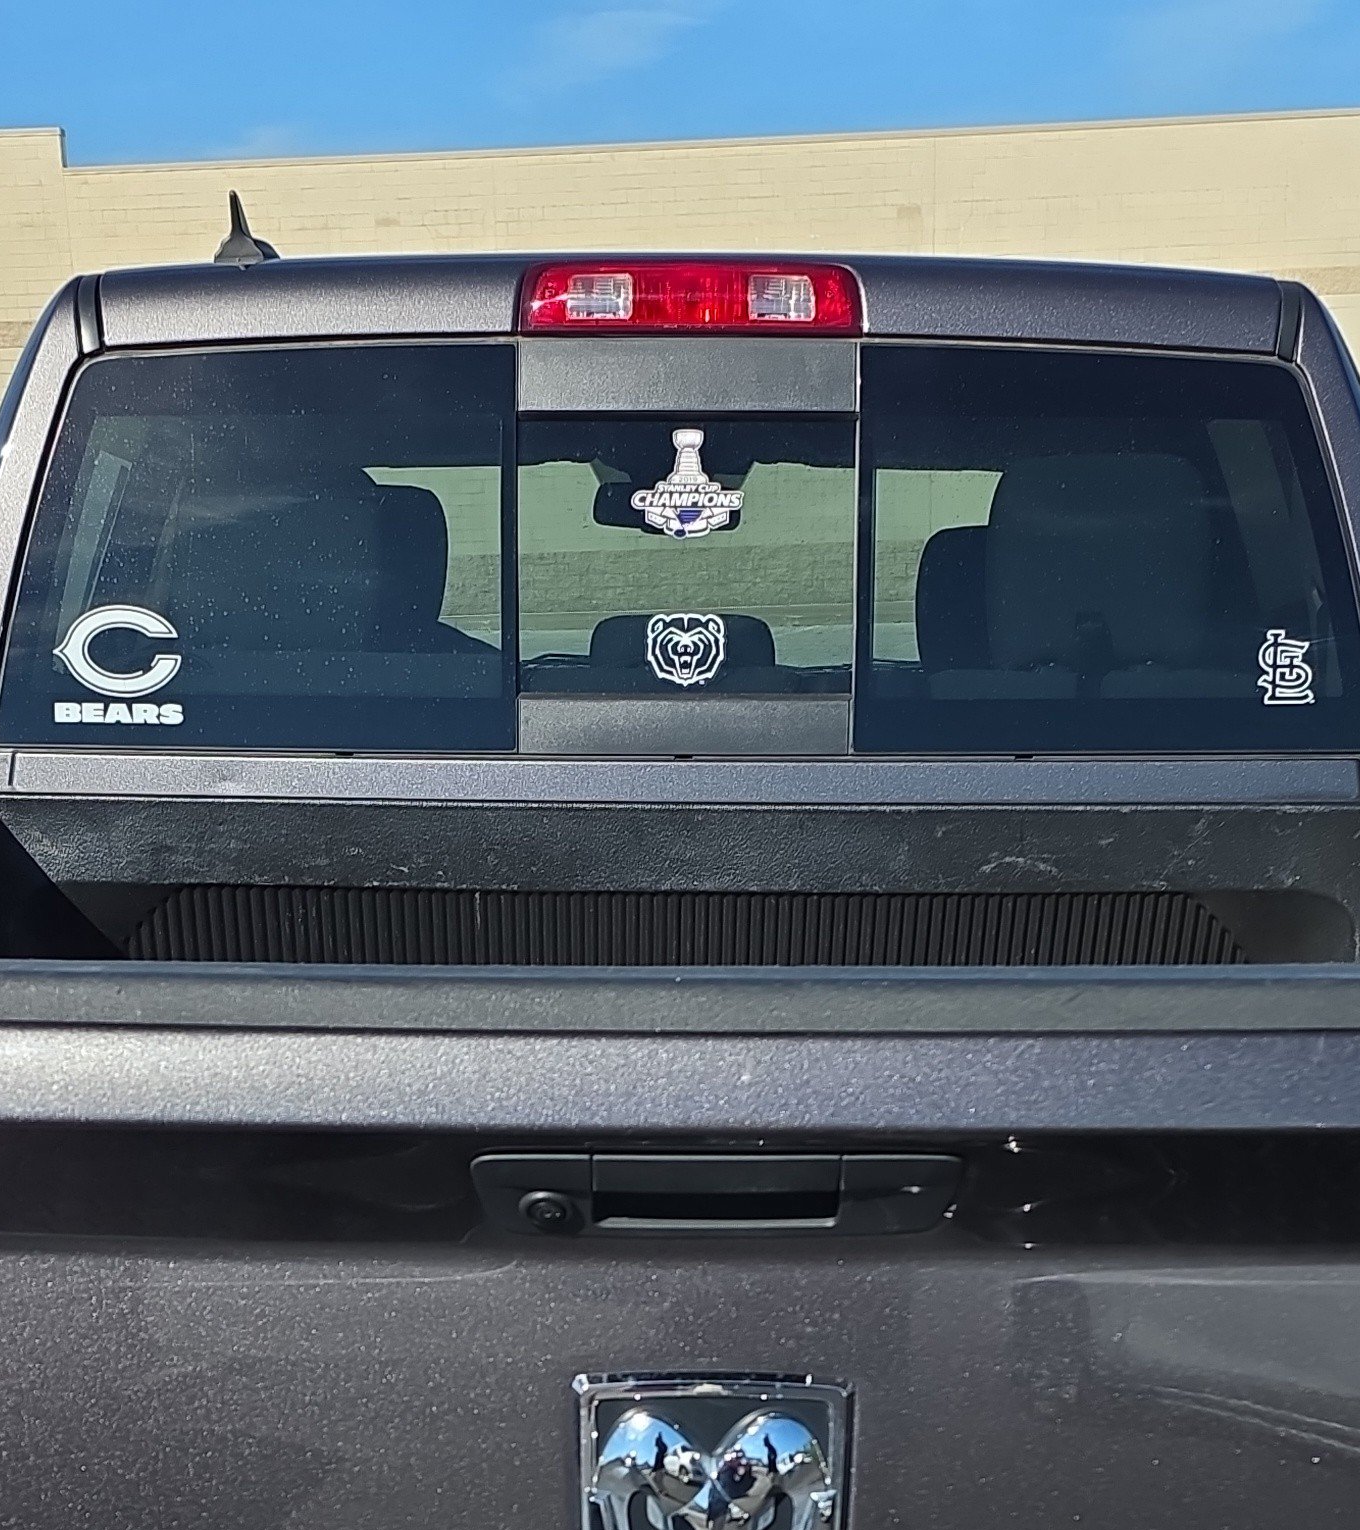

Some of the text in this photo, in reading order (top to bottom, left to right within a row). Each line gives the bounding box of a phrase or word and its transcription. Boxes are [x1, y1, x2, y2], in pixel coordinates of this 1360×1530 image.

[678, 475, 698, 483] 2019
[633, 493, 741, 507] CHAMPIONS
[53, 702, 185, 725] BEARS
